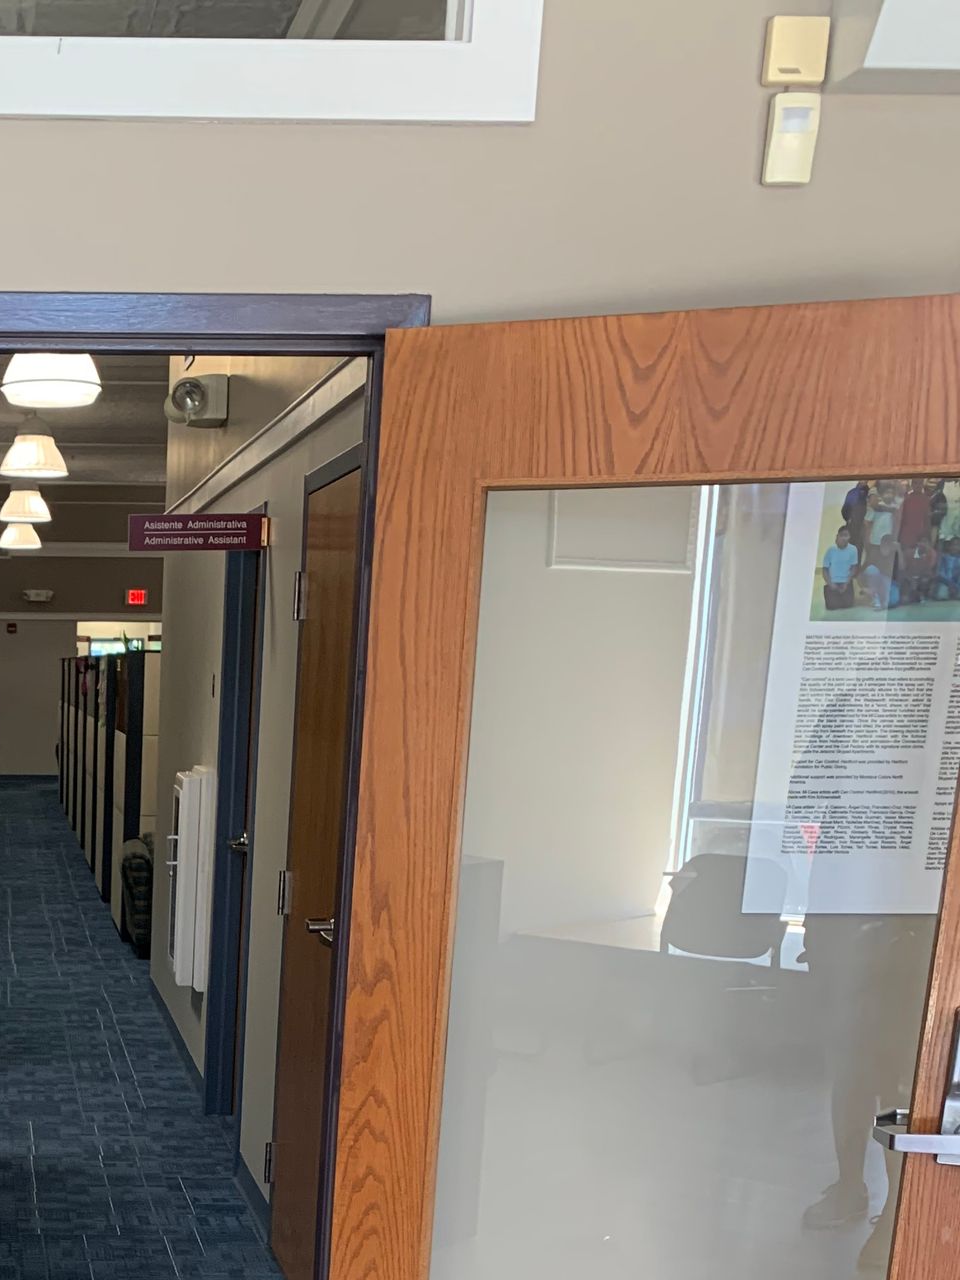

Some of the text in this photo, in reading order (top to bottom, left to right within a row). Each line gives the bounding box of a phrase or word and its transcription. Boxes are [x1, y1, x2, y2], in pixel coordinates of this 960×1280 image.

[144, 519, 247, 530] Asistente Administrativa
[144, 536, 246, 545] Administrative Assistant
